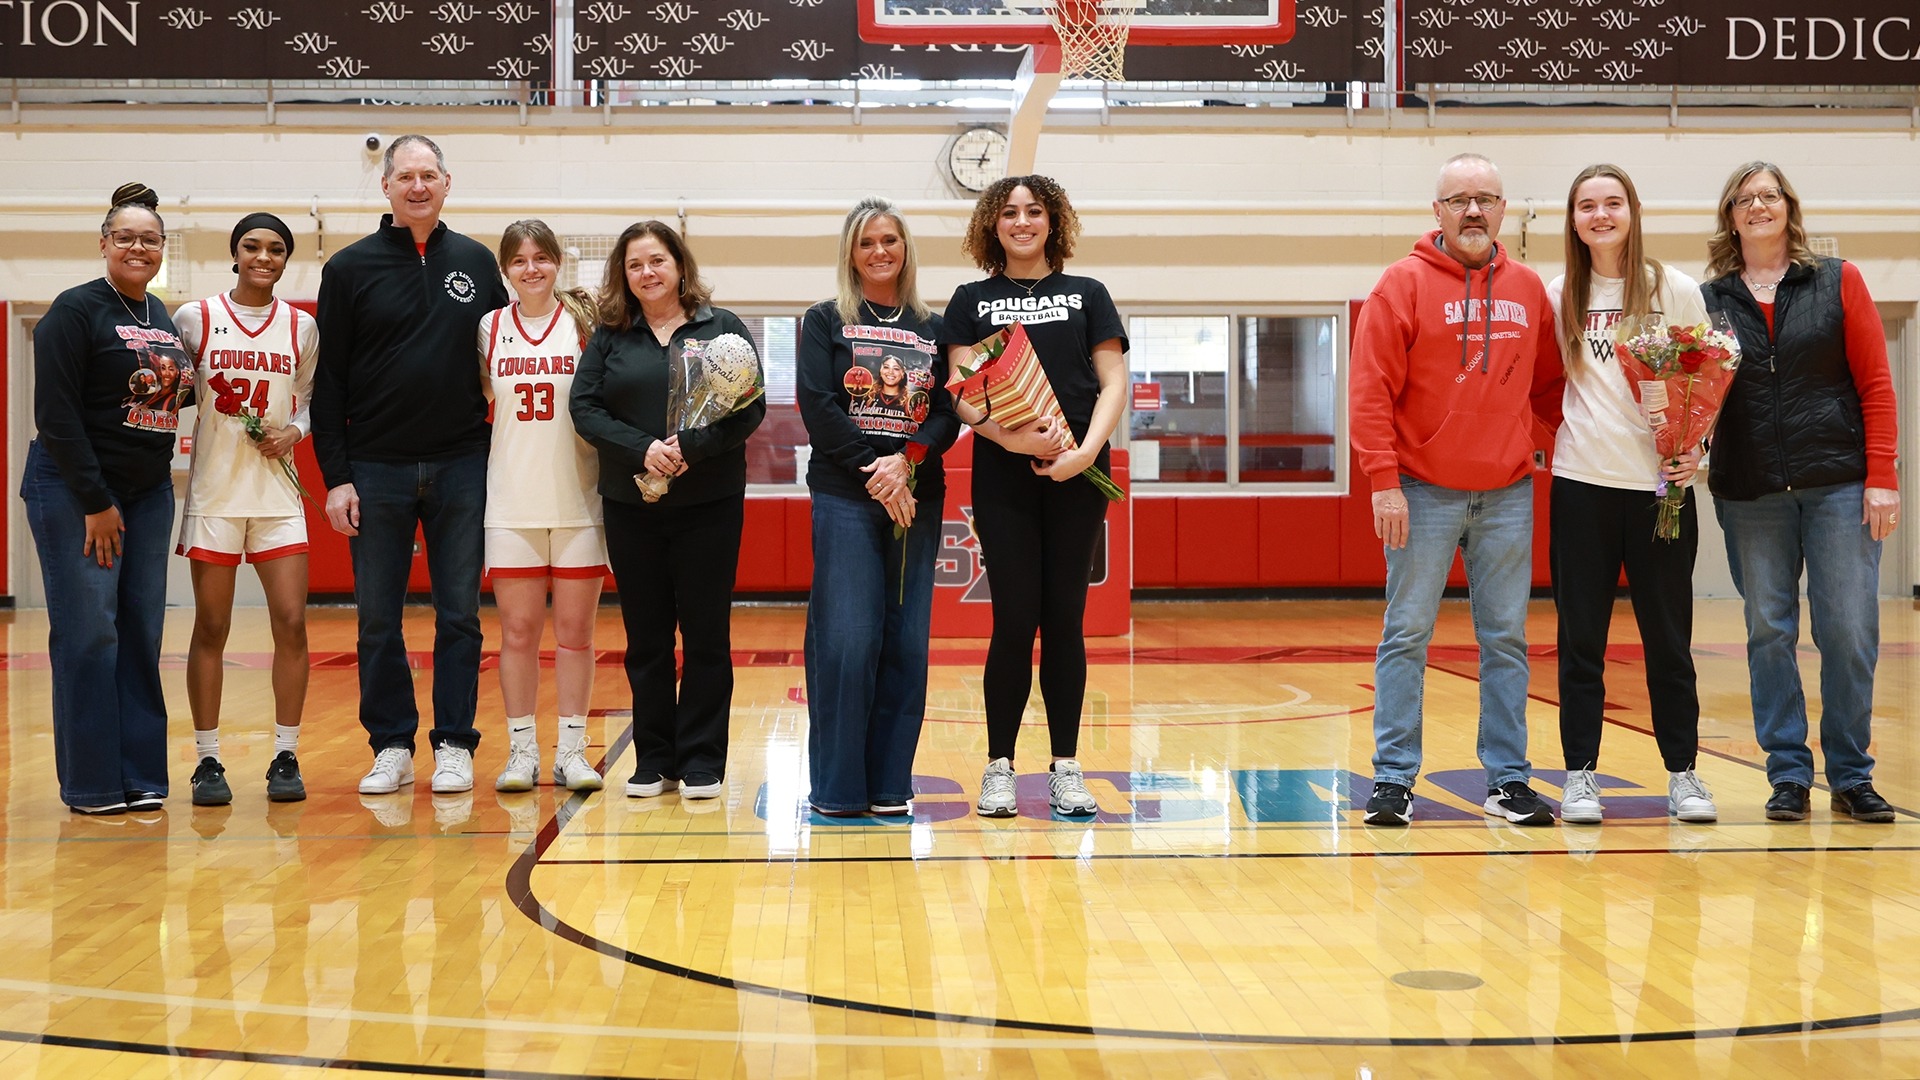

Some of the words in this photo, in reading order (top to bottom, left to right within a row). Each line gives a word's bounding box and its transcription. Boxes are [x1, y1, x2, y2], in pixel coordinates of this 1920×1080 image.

[167, 8, 204, 29] SXU
[236, 8, 273, 29] SXU
[369, 2, 405, 23] SXU
[437, 2, 474, 23] SXU
[495, 3, 532, 23] SXU
[586, 2, 624, 23] SXU
[654, 2, 692, 23] SXU
[725, 10, 763, 30] SXU
[1304, 6, 1340, 27] SXU
[1418, 8, 1453, 28] SXU
[1472, 9, 1507, 28] SXU
[1536, 9, 1571, 29] SXU
[1599, 10, 1633, 29] SXU
[1665, 16, 1699, 36] SXU
[292, 33, 330, 53] SXU
[429, 34, 466, 54] SXU
[622, 33, 660, 54] SXU
[690, 33, 727, 54] SXU
[1411, 38, 1446, 58] SXU
[1506, 38, 1540, 58] SXU
[1725, 17, 1920, 60] DEDIC
[790, 40, 827, 61] SXU
[1569, 39, 1603, 59] SXU
[1632, 39, 1666, 59] SXU
[325, 57, 362, 77] SXU
[495, 58, 532, 78] SXU
[590, 57, 627, 77] SXU
[658, 57, 695, 77] SXU
[1262, 60, 1298, 81] SXU
[1472, 61, 1507, 80] SXU
[1539, 61, 1573, 80] SXU
[1602, 61, 1636, 81] SXU
[977, 294, 1083, 318] COUGARS
[998, 310, 1061, 322] BASKETBALL
[842, 325, 917, 343] SENIOR
[1456, 333, 1484, 341] WMENS
[209, 349, 292, 375] COUGARS
[497, 355, 575, 378] COUGARS
[704, 347, 741, 385] Congrats!
[1455, 373, 1466, 384] GO
[1465, 350, 1484, 372] COUGS
[514, 382, 555, 421] 33
